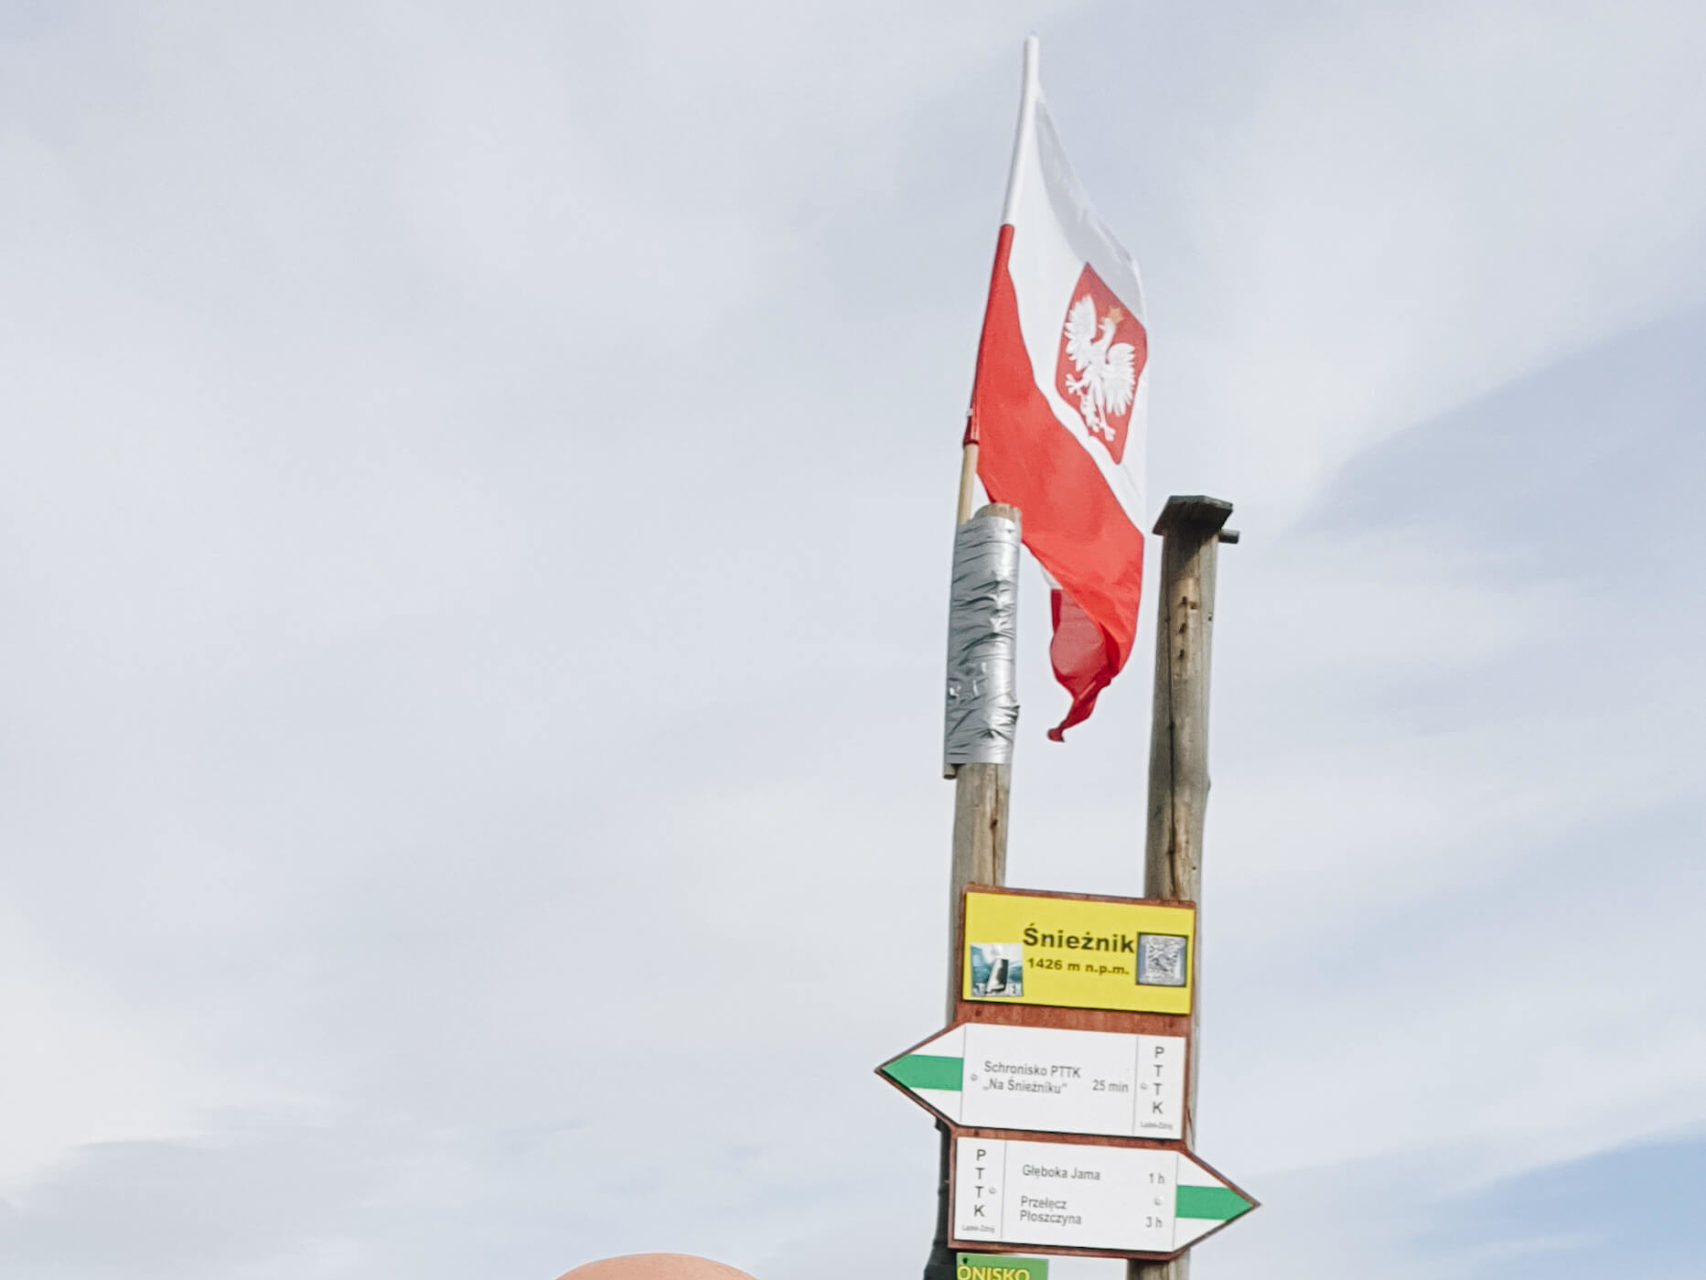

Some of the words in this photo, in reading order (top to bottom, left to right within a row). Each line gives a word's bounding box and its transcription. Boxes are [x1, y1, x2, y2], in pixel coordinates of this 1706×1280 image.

[1023, 923, 1135, 954] Śnieżnik
[1028, 958, 1062, 971] 1426
[1067, 963, 1080, 972] m
[1085, 964, 1130, 976] n.p.m.
[984, 1060, 1048, 1076] Schronisko
[1050, 1065, 1081, 1079] PTTK
[1092, 1080, 1106, 1091] 25
[1108, 1081, 1129, 1093] min
[1070, 1168, 1101, 1181] Jama
[1148, 1172, 1154, 1184] 1
[1157, 1172, 1165, 1185] h
[1145, 1216, 1153, 1229] 3
[1155, 1216, 1163, 1229] h
